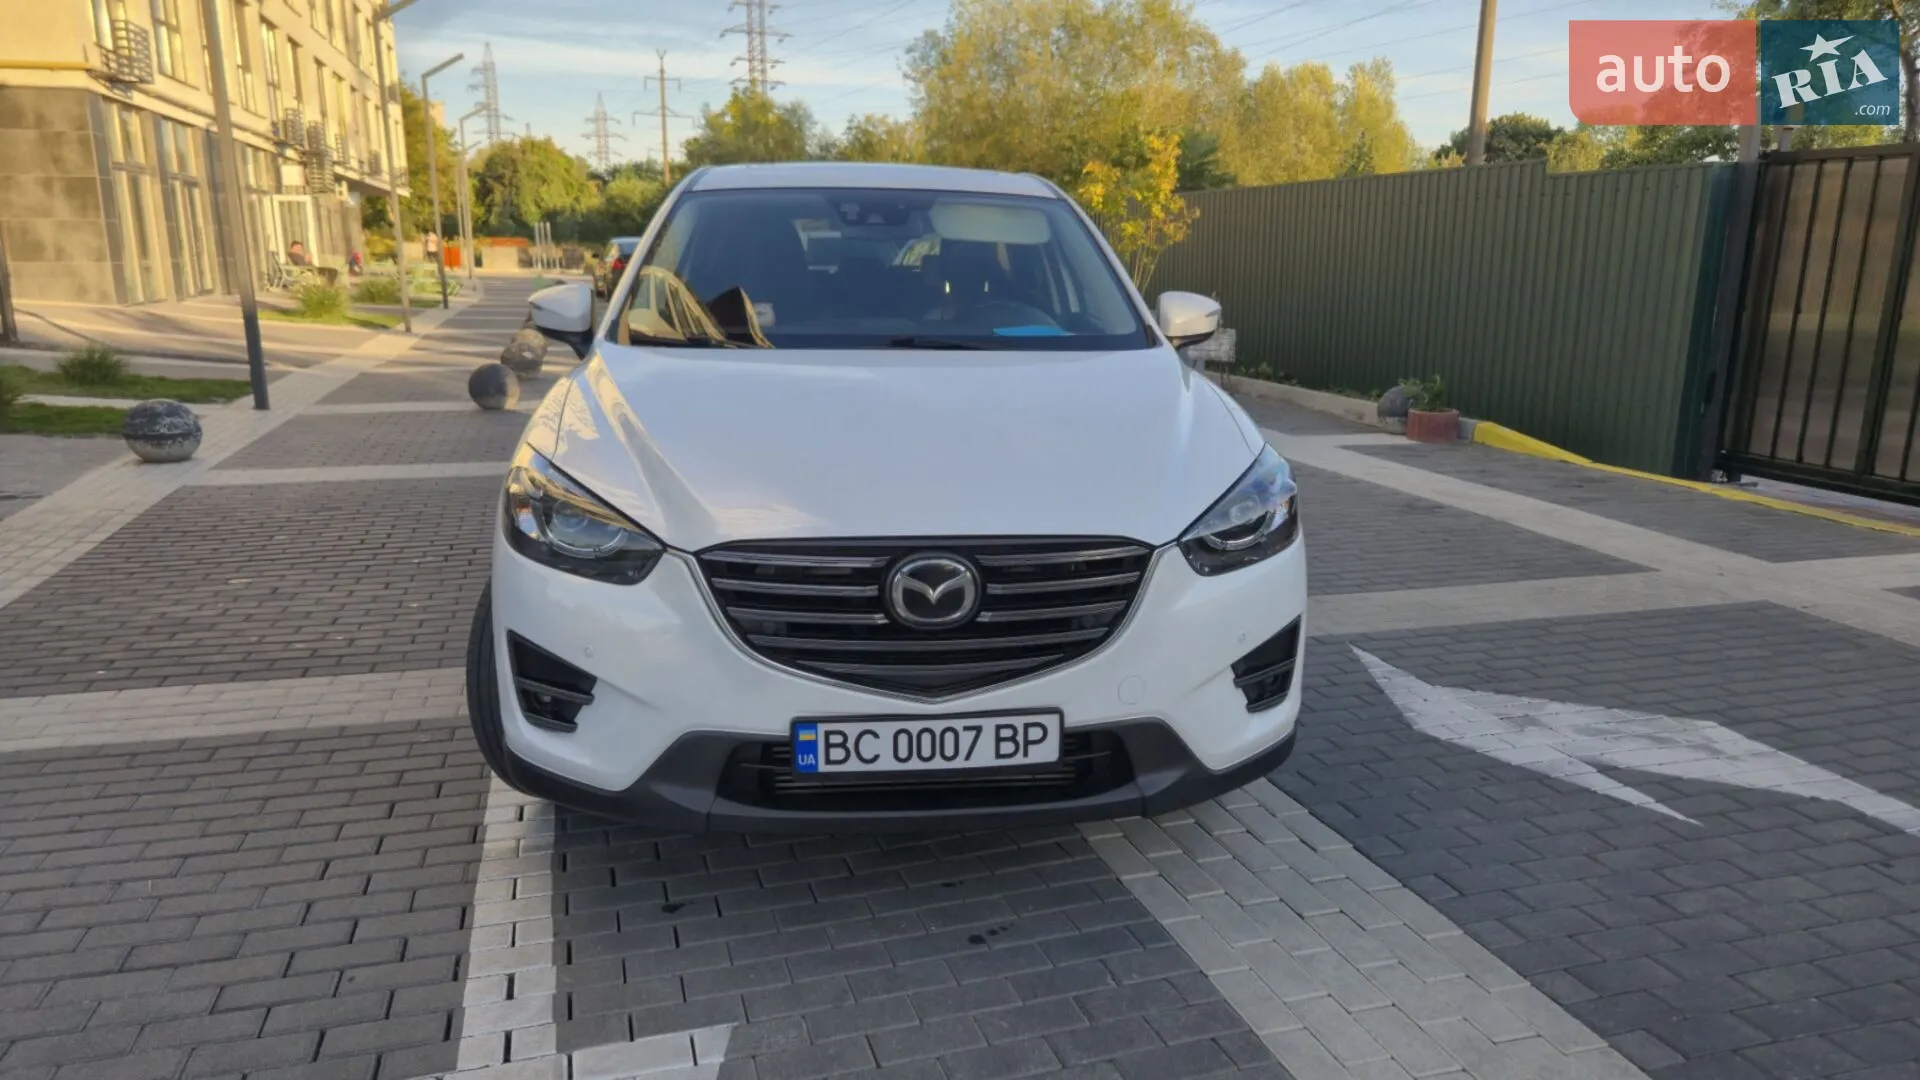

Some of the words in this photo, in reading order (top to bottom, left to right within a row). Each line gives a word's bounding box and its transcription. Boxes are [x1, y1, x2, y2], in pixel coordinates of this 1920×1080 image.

[823, 728, 881, 766] BC
[892, 724, 984, 764] 0007
[994, 721, 1049, 760] BP
[798, 754, 816, 766] UA
